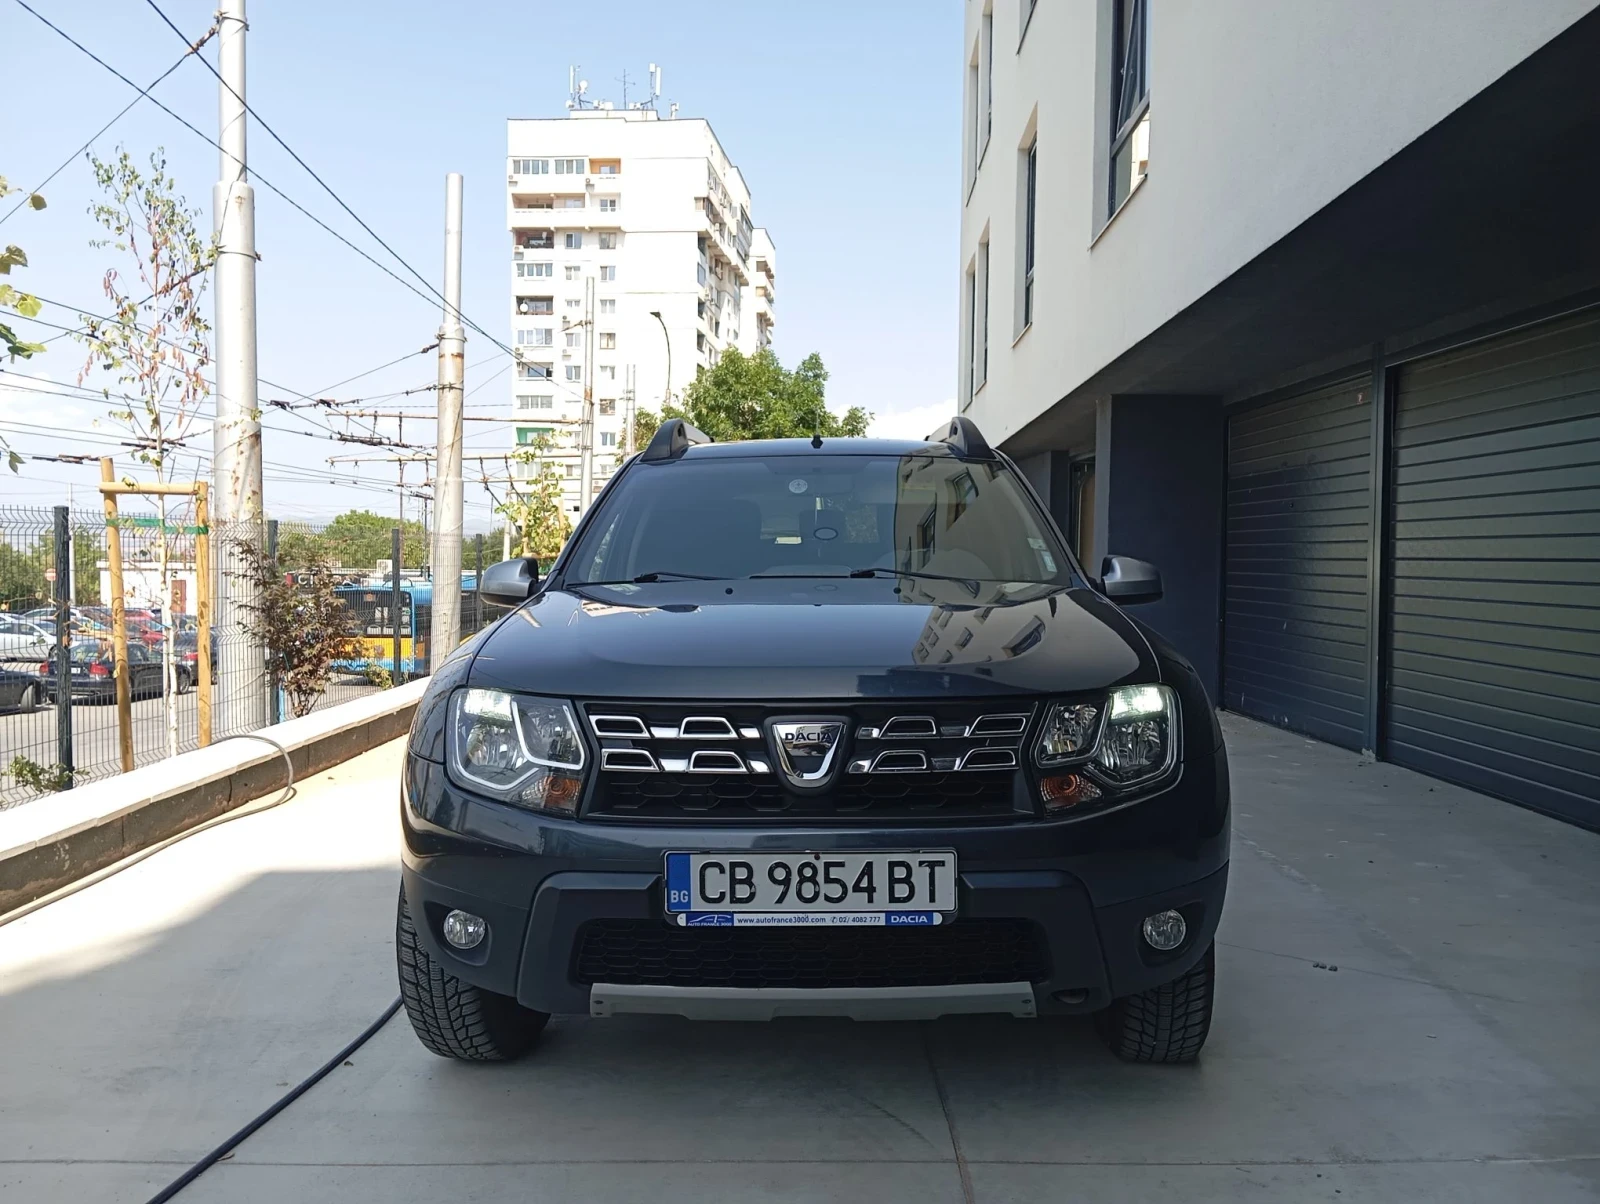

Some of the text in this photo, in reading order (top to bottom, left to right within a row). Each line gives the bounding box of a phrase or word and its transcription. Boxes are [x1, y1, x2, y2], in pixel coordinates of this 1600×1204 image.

[784, 732, 833, 741] DACIA
[700, 860, 945, 904] CB 9854 BT
[671, 891, 689, 903] BG
[737, 915, 826, 924] www.autofrance3000.com
[890, 915, 928, 924] DACIA
